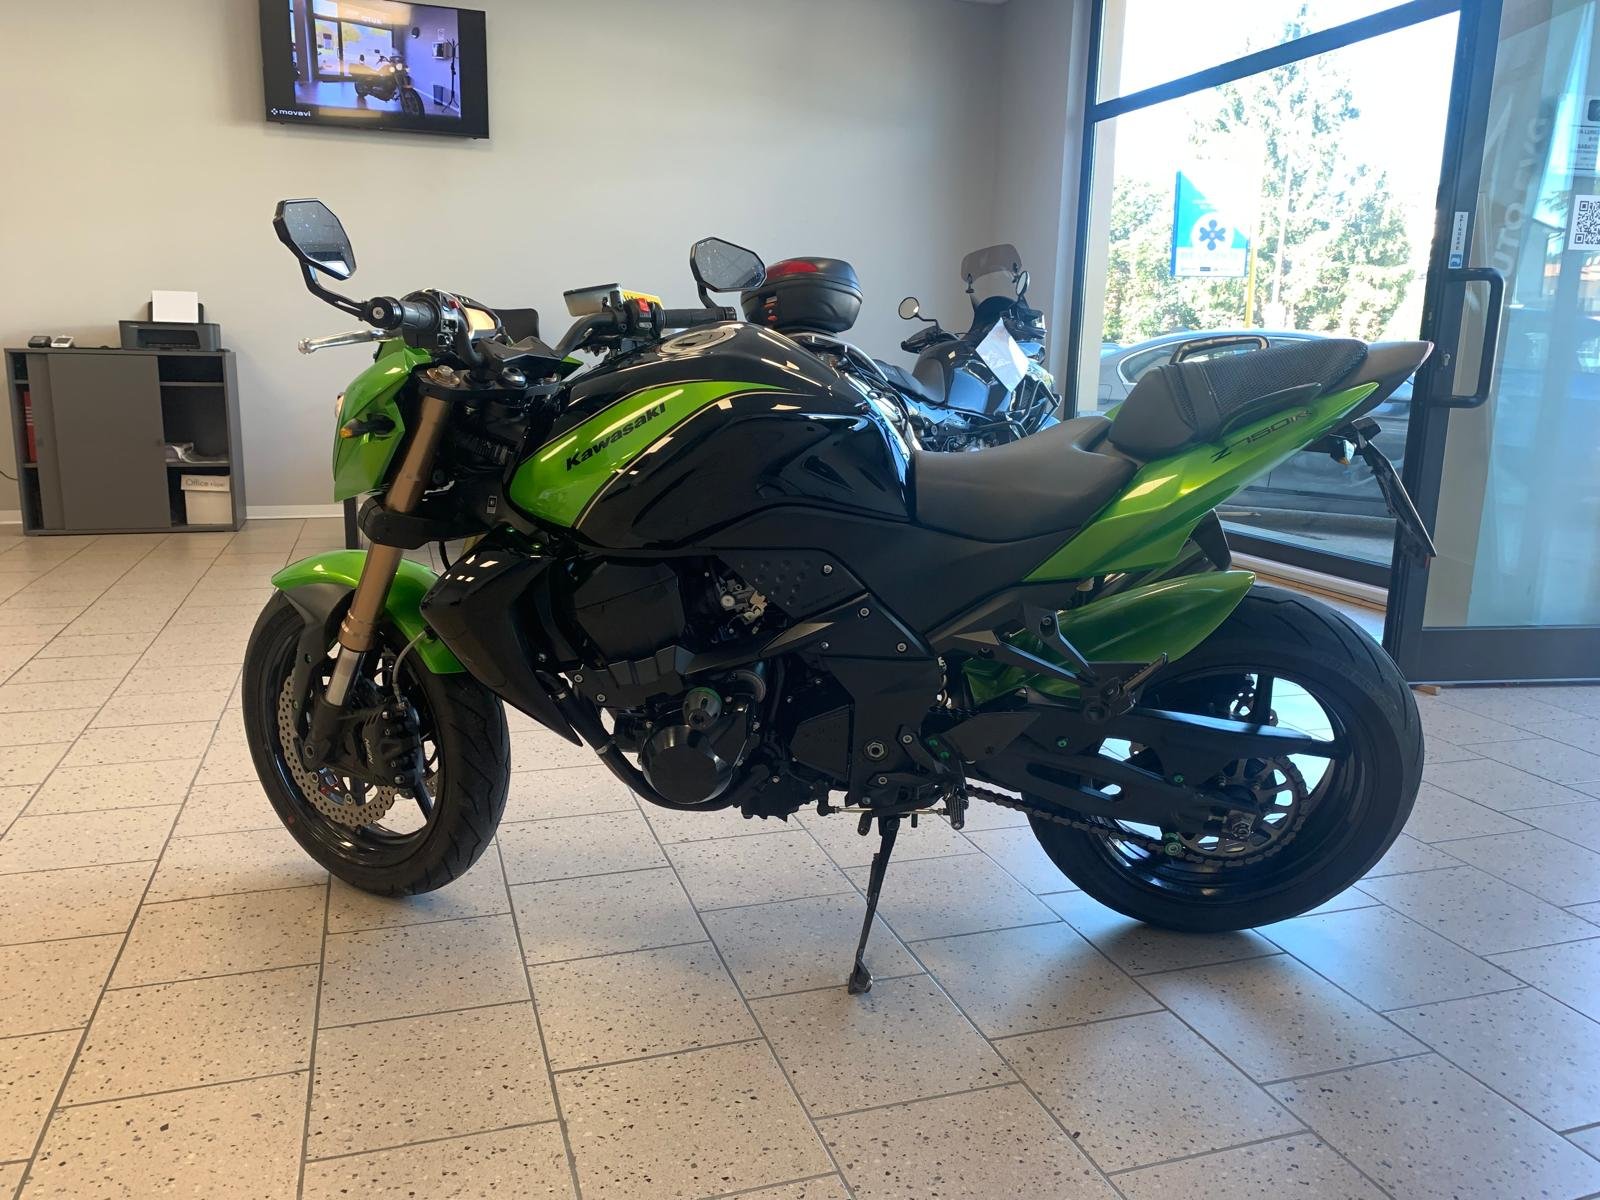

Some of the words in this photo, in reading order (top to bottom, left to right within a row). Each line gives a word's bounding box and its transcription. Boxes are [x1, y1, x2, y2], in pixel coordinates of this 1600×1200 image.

[279, 109, 311, 117] movavi
[565, 402, 666, 472] Kawasaki
[186, 478, 208, 487] Office
